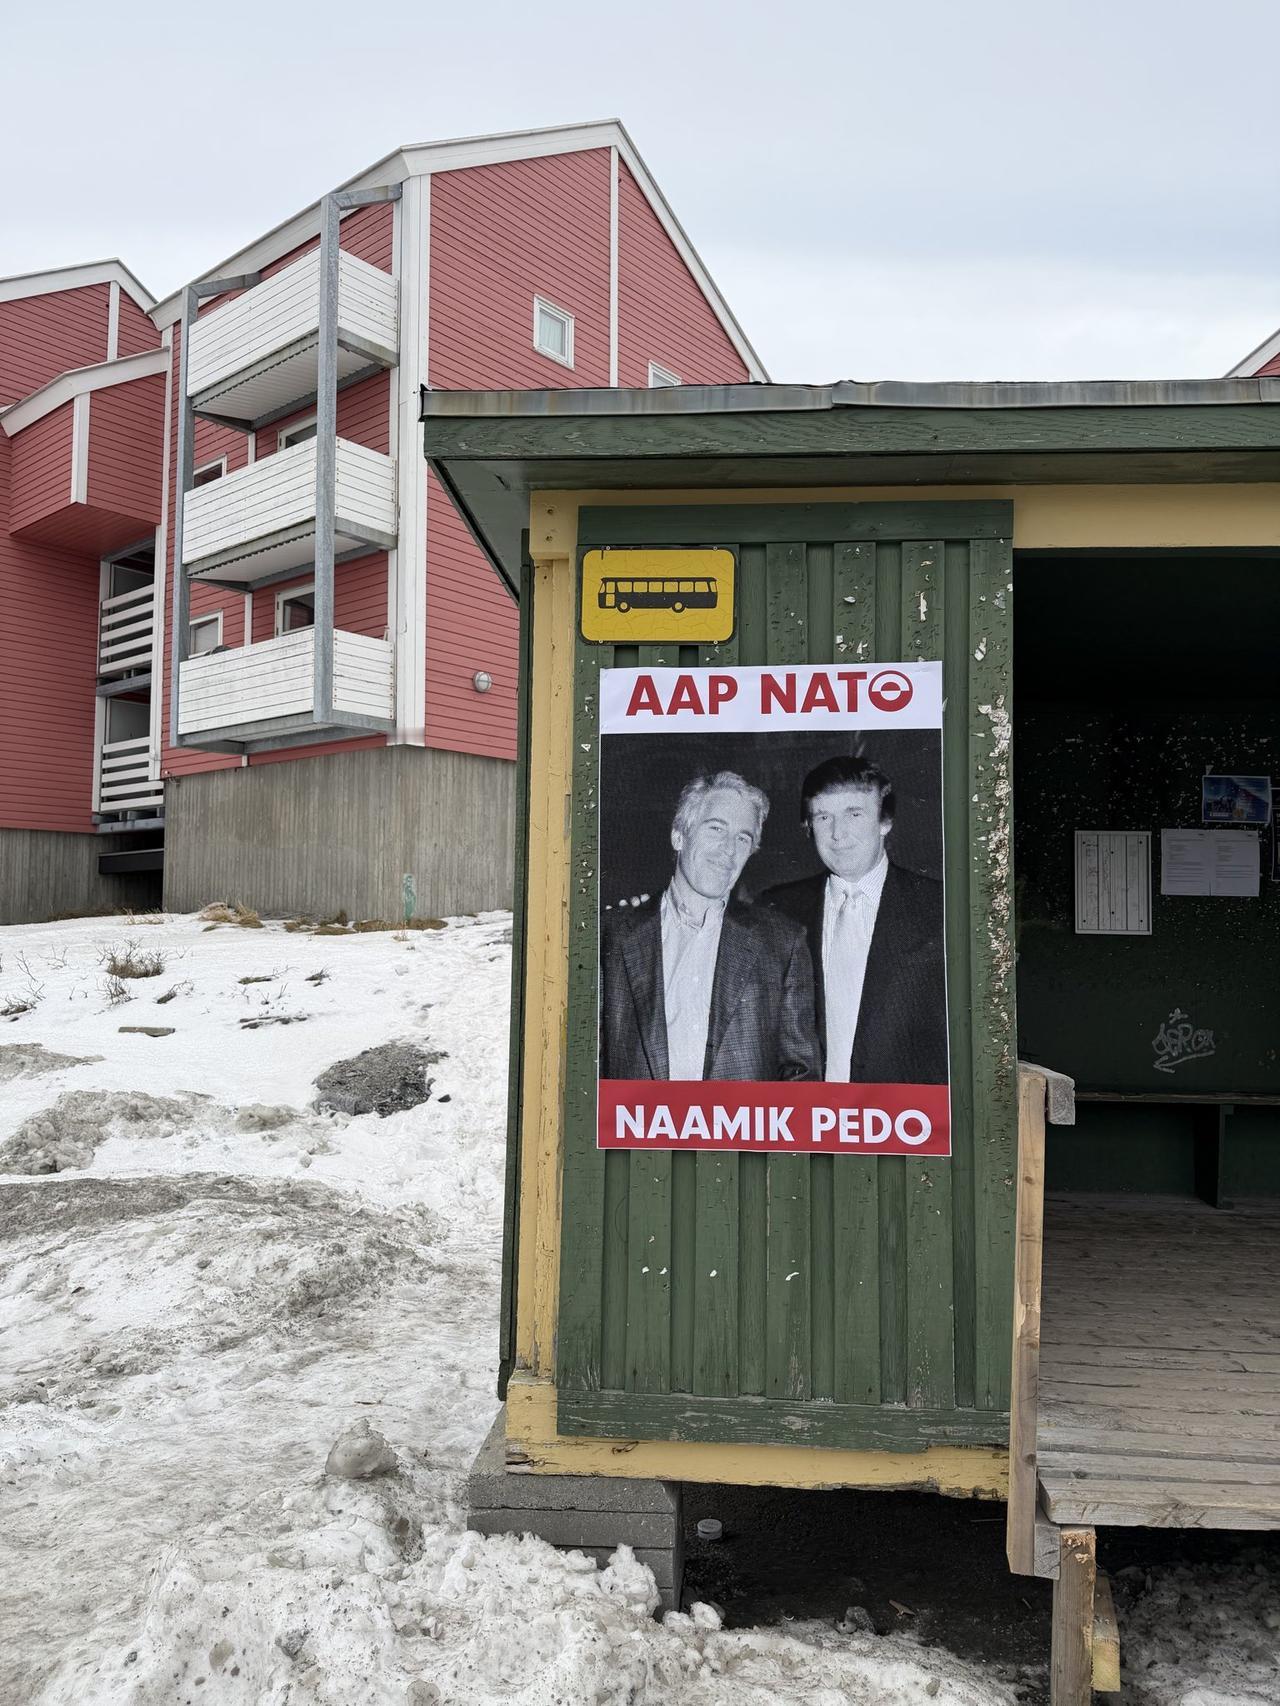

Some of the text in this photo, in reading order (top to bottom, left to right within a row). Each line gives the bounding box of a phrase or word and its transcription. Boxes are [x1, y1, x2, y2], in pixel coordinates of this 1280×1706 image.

[626, 670, 913, 717] AAP NATO
[615, 1104, 932, 1146] NAAMIK PEDO
